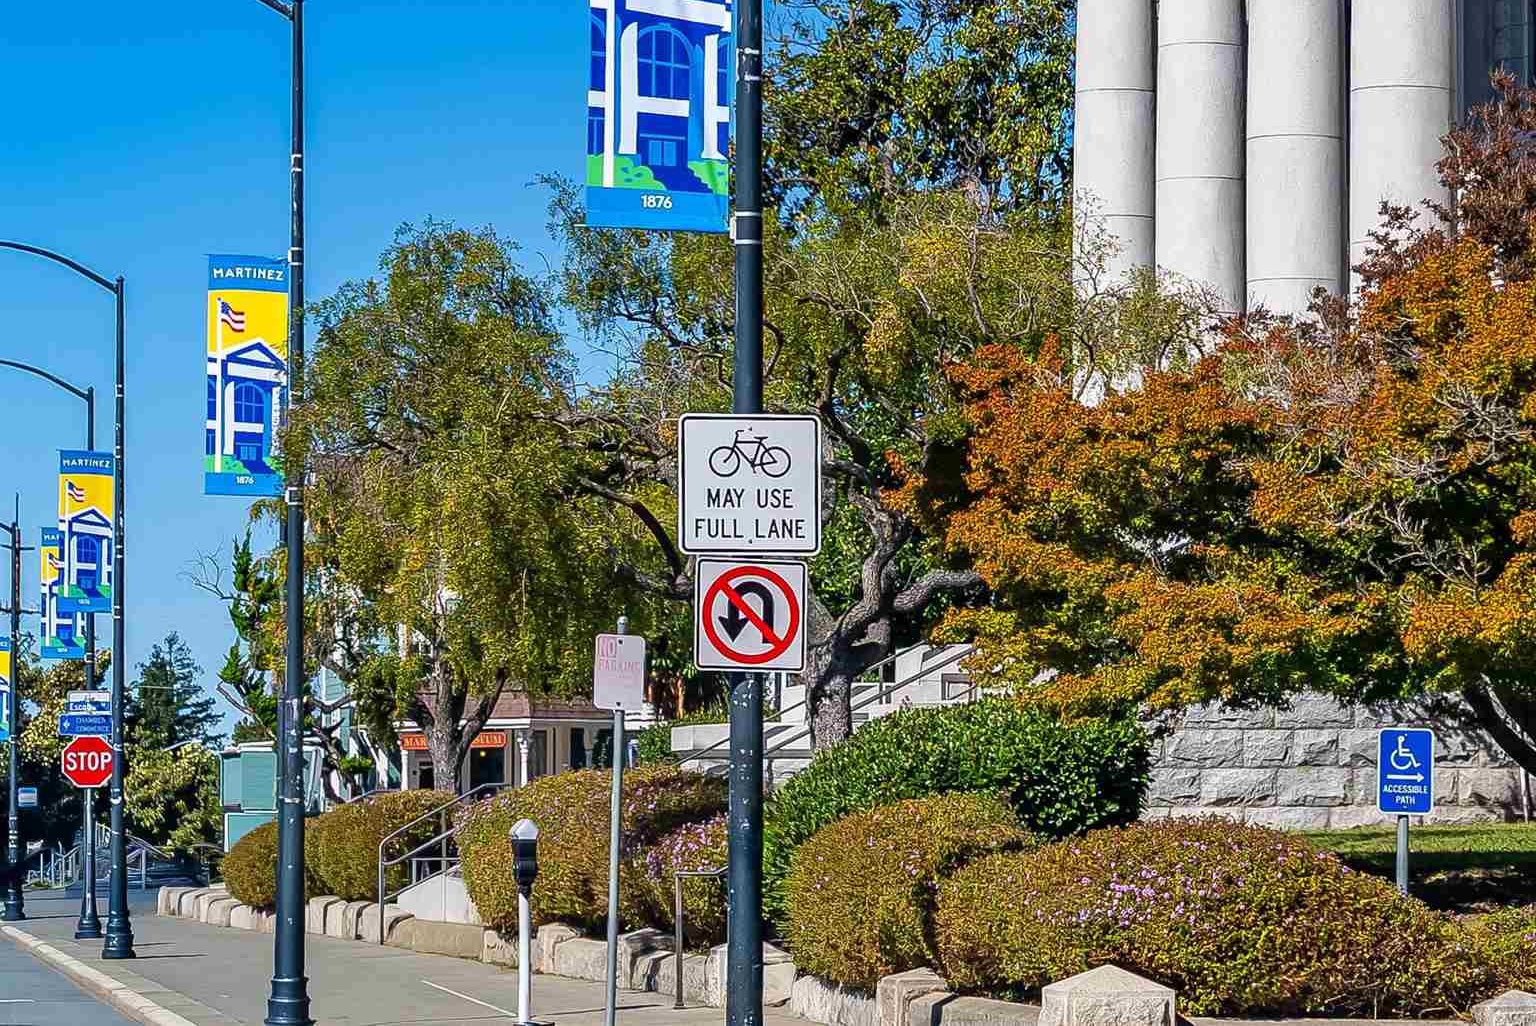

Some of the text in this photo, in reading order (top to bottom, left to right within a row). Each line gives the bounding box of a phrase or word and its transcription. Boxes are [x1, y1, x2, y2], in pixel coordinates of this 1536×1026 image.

[641, 195, 672, 209] 1876
[213, 267, 284, 281] MARTINEZ
[63, 459, 111, 469] MARTINEZ
[236, 476, 254, 485] 1876
[707, 488, 793, 508] MAY USE
[695, 518, 806, 538] FULL LANE
[600, 637, 616, 655] NO
[66, 751, 112, 772] STOP
[1383, 784, 1428, 794] ACCESSIBLE
[1395, 795, 1416, 805] PATH
